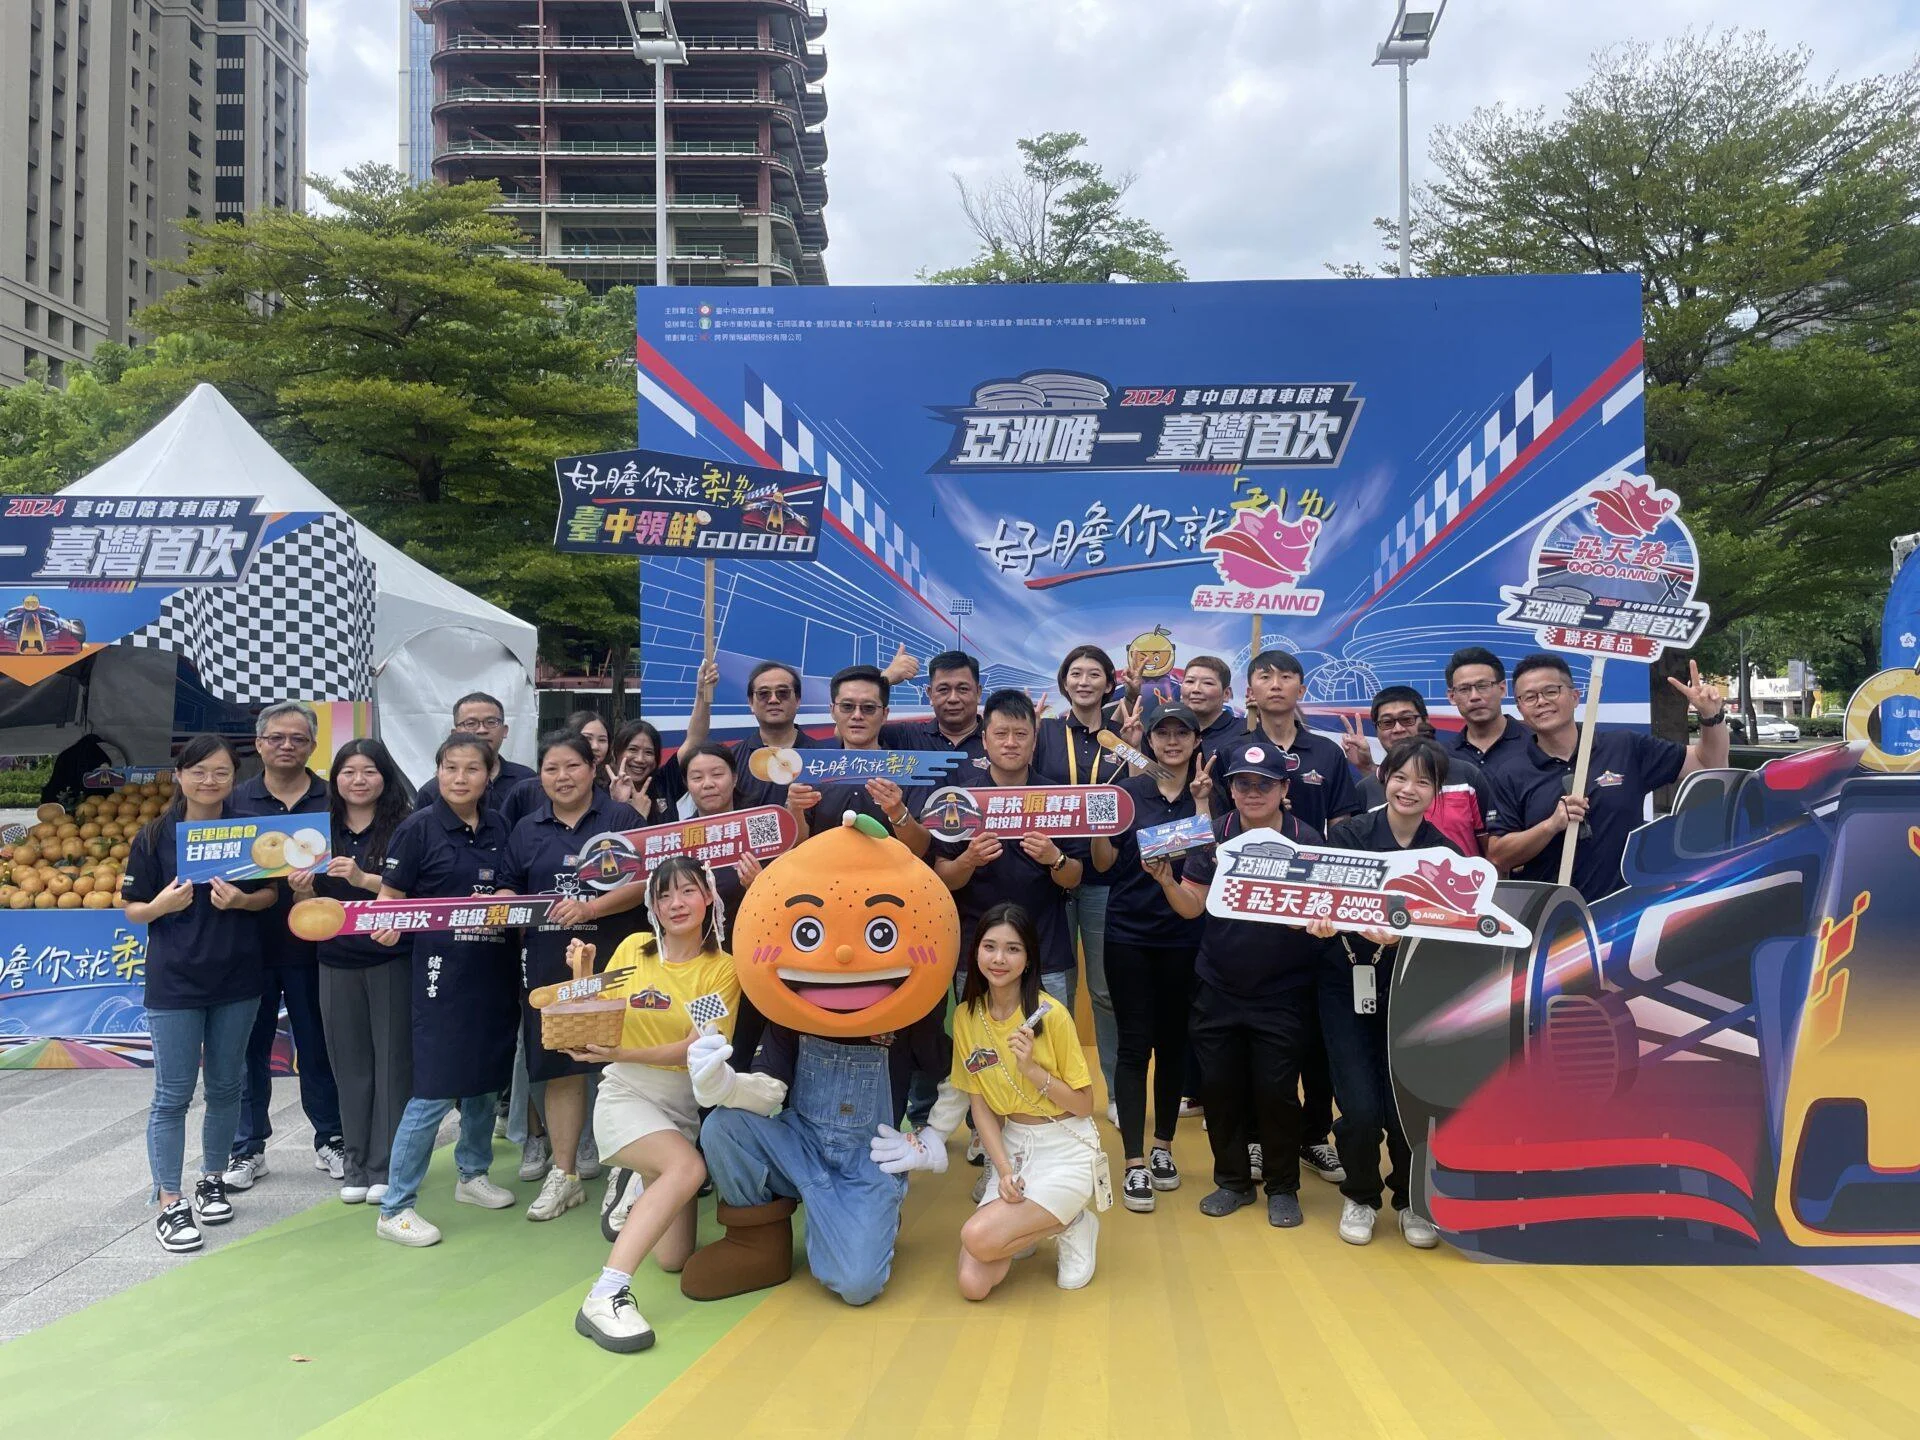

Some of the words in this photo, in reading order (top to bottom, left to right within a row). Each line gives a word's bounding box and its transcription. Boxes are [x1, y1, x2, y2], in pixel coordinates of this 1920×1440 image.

[1120, 388, 1177, 406] 2024
[1181, 387, 1335, 406] 臺中國際賽車展演
[950, 414, 1142, 465] 亞洲唯一
[1147, 411, 1342, 462] 臺灣首次
[5, 499, 66, 517] 2024
[72, 500, 241, 518] 臺中國際賽車展演
[567, 505, 700, 547] 臺中領鮮
[32, 524, 249, 578] 臺灣首次
[1616, 568, 1658, 582] ANNO
[1520, 600, 1604, 626] 亞洲唯一
[1605, 610, 1695, 639] 臺灣首次
[1563, 631, 1634, 653] 聯名產品
[987, 792, 1081, 814] 農來瘋賽車
[645, 821, 742, 855] 農來瘋賽車
[186, 841, 242, 862] 甘露梨
[1234, 856, 1306, 879] 亞洲唯一
[1306, 863, 1382, 888] 臺灣首次
[1340, 895, 1382, 909] ANNO
[1422, 911, 1445, 920] ANNO
[556, 978, 602, 1002] 金梨嗨
